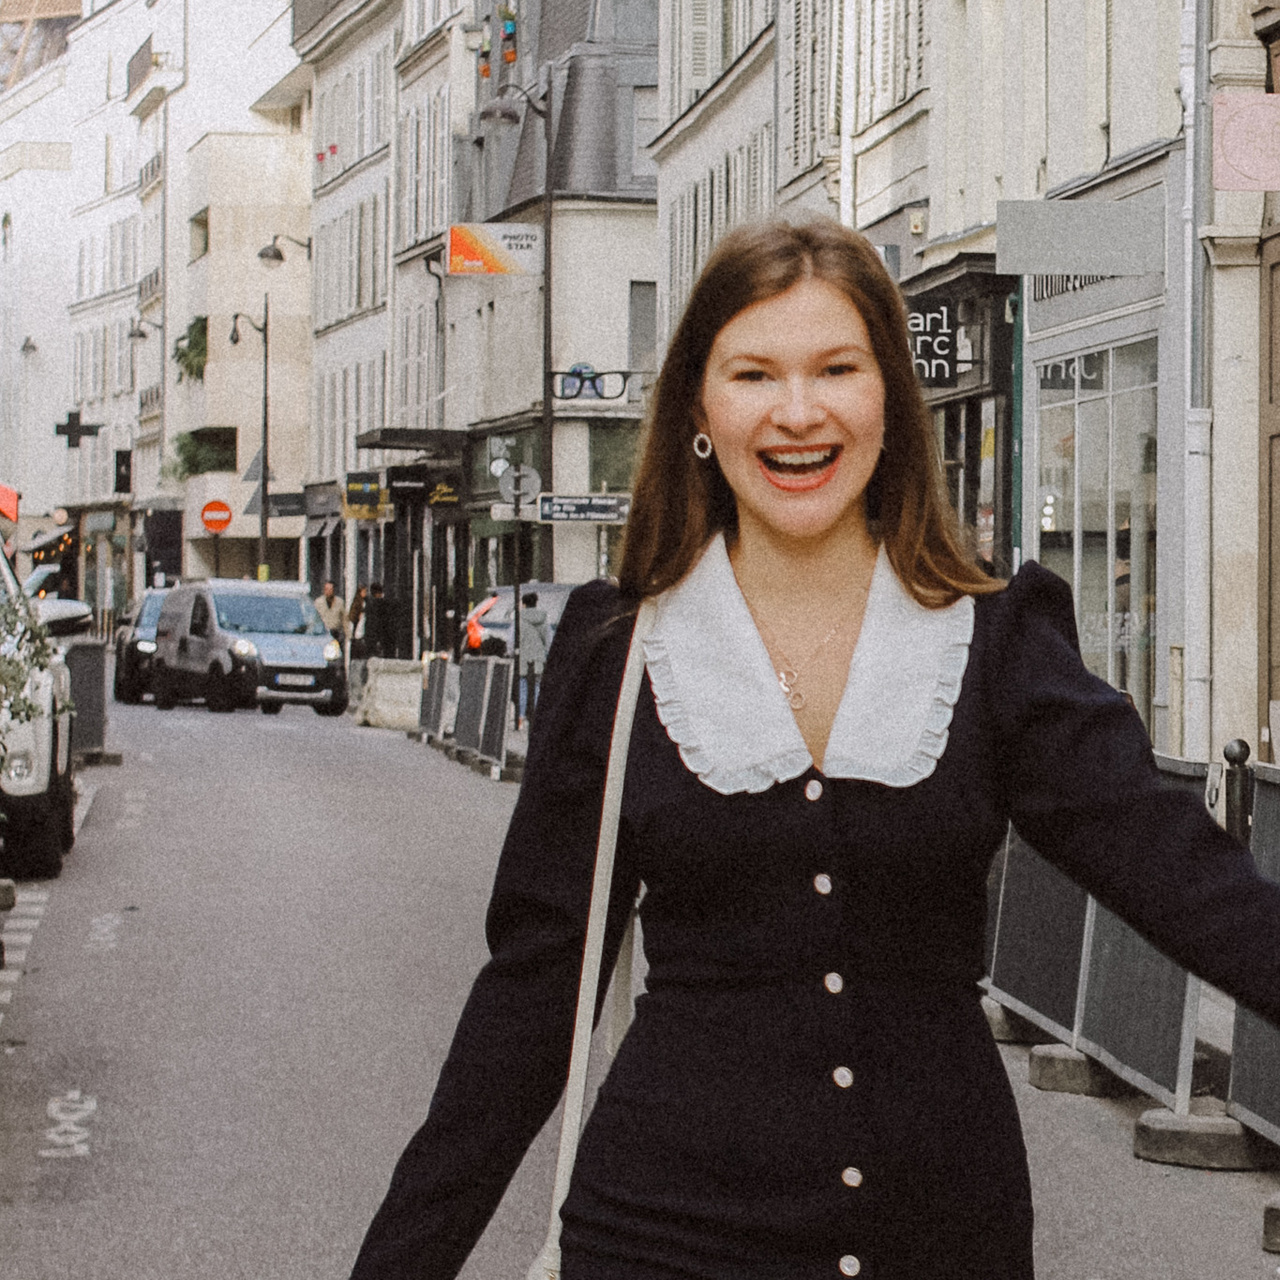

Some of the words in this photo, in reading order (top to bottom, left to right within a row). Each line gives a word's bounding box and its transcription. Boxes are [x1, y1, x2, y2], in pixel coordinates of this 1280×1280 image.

[907, 306, 952, 334] arl
[908, 335, 950, 355] rc
[911, 351, 950, 378] hn
